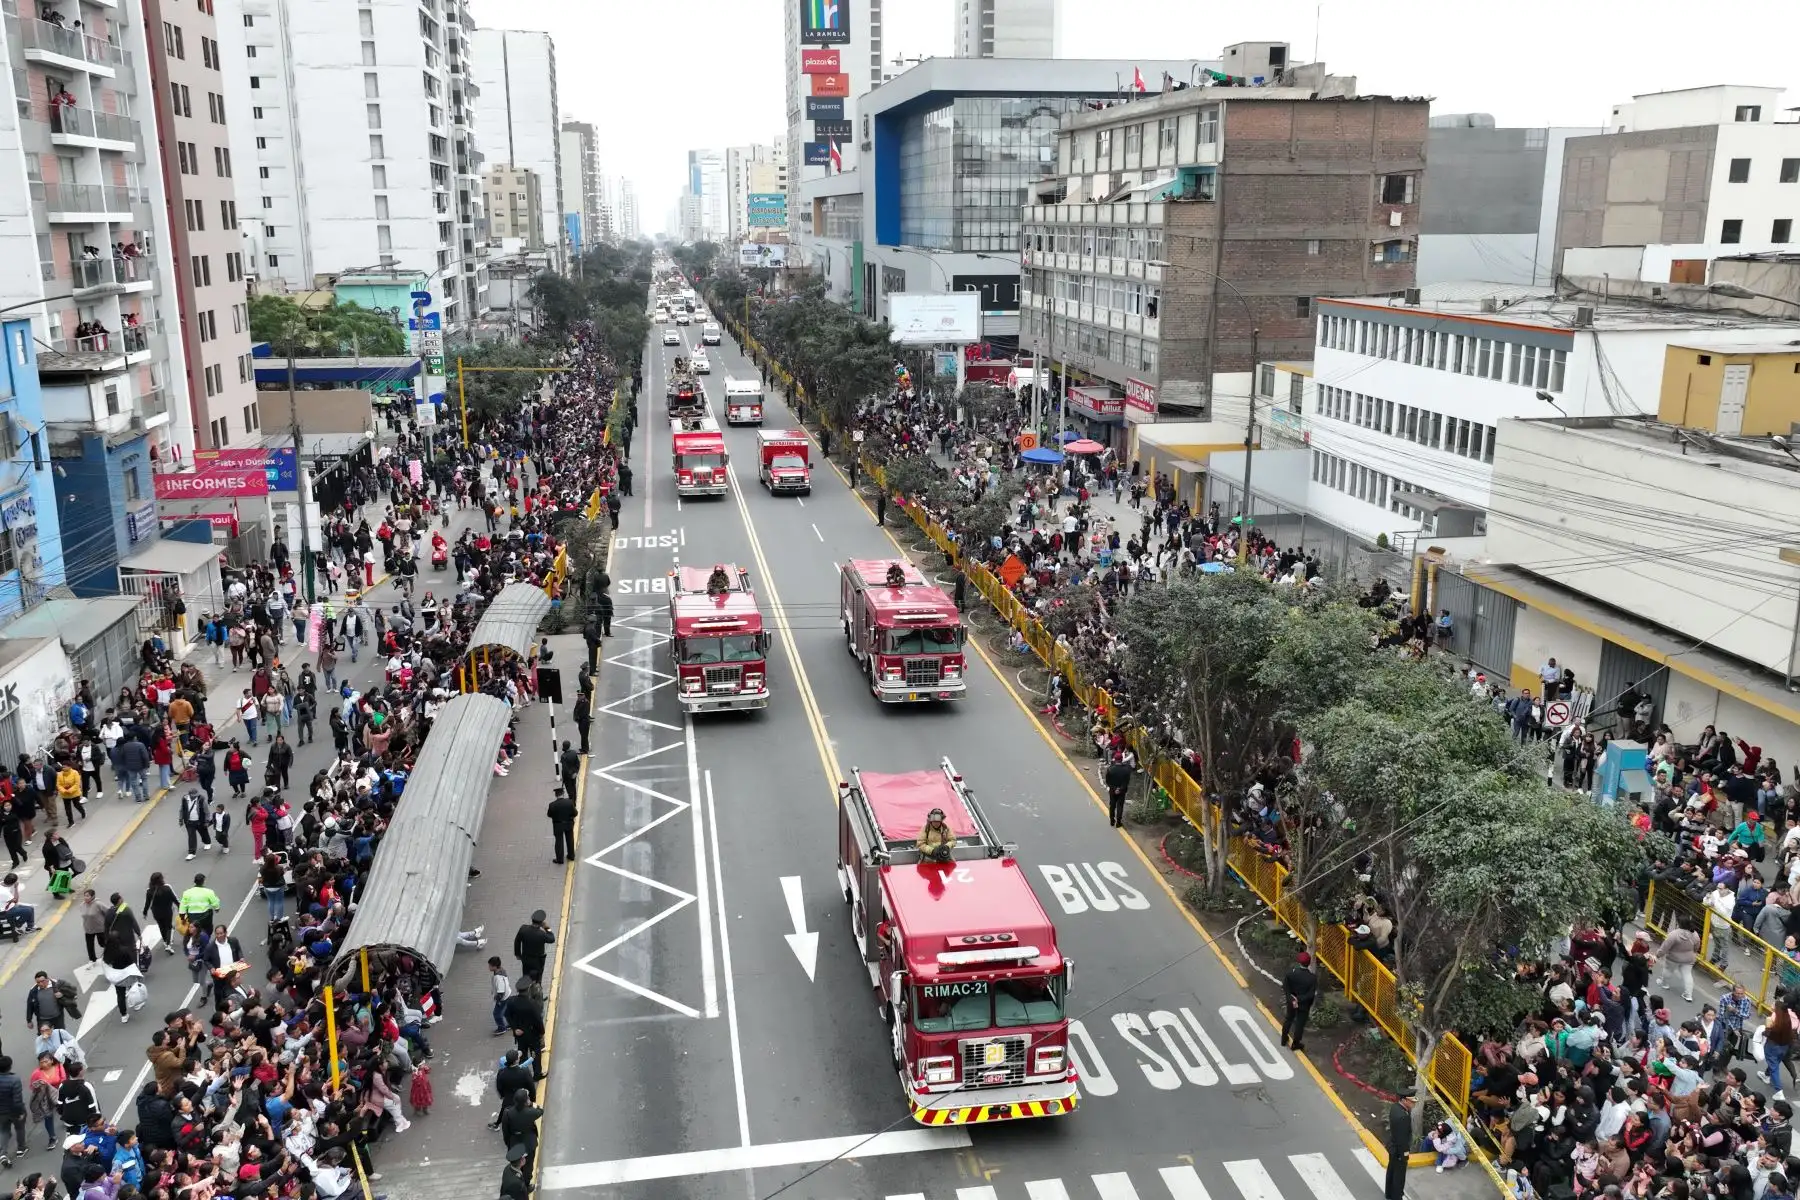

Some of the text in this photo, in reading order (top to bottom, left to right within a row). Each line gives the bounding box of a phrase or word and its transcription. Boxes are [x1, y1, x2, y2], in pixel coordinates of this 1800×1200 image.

[166, 477, 246, 491] INFORMES
[615, 535, 672, 549] SOLO
[618, 577, 666, 594] BUS
[1038, 861, 1151, 914] BUS
[924, 982, 988, 998] RIMAC-21
[987, 1046, 1004, 1063] 21
[1111, 1005, 1295, 1090] SOLO
